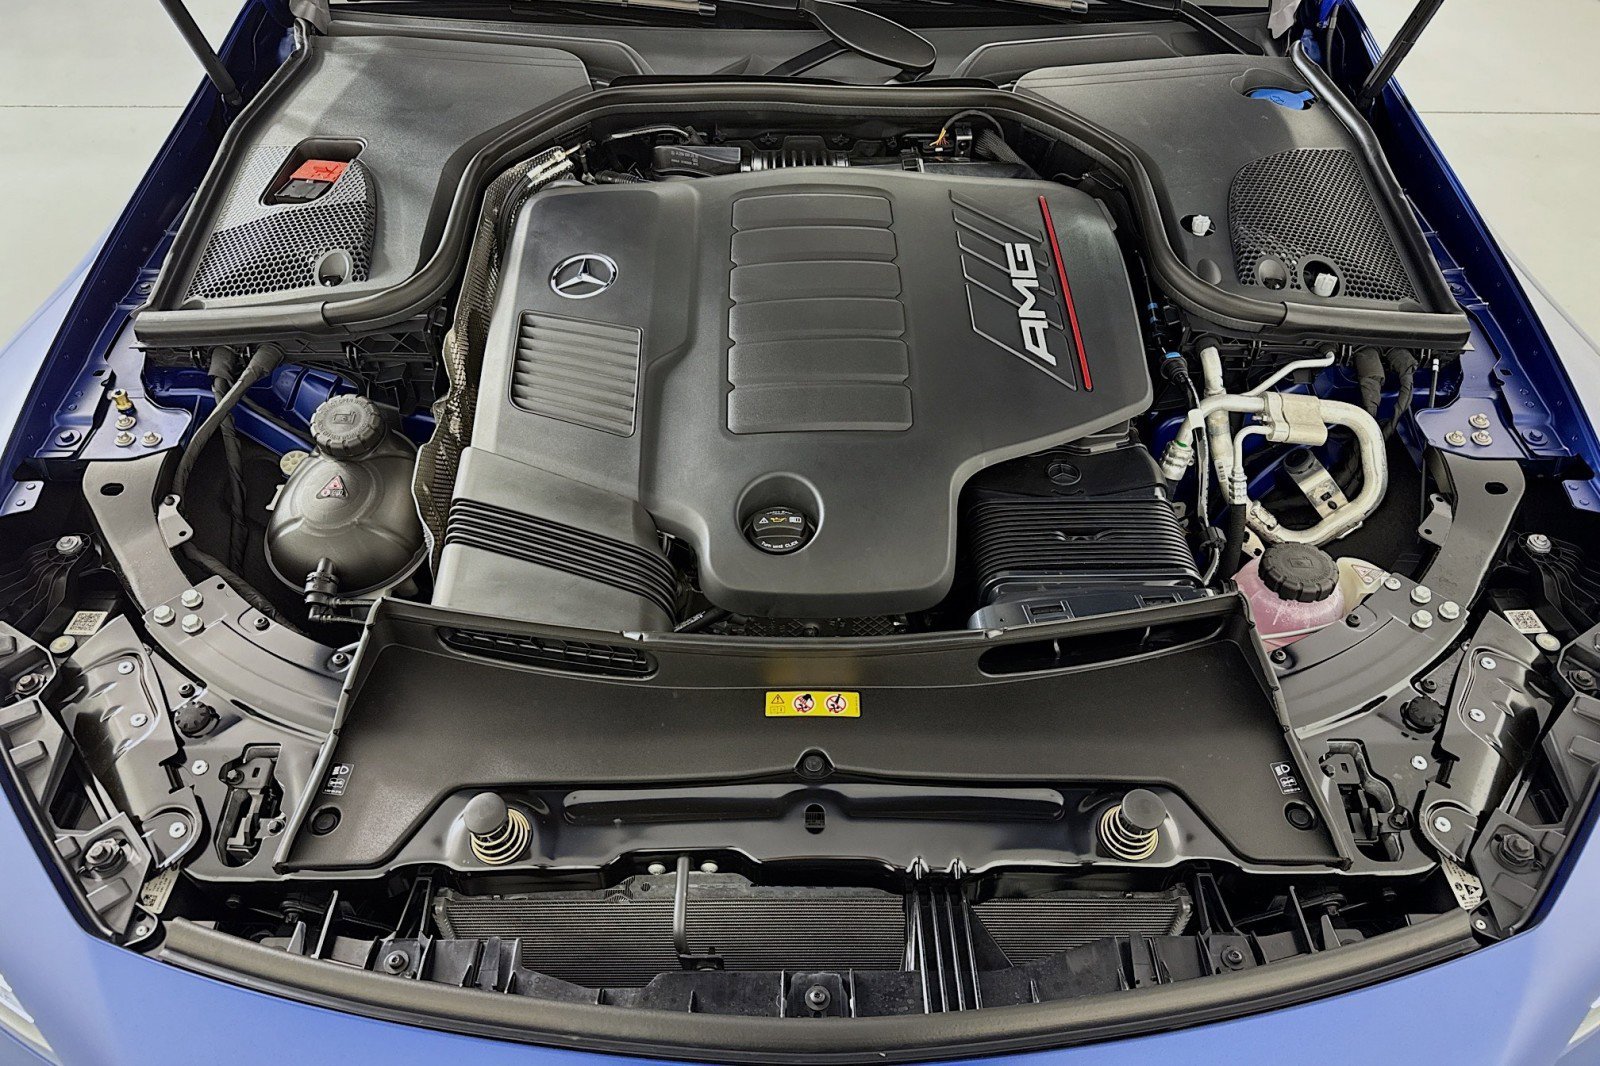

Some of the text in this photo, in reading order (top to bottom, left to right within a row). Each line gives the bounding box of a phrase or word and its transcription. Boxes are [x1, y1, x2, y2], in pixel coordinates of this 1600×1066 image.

[1004, 242, 1057, 366] AMG
[761, 540, 772, 548] Turn
[784, 540, 799, 548] CLICK
